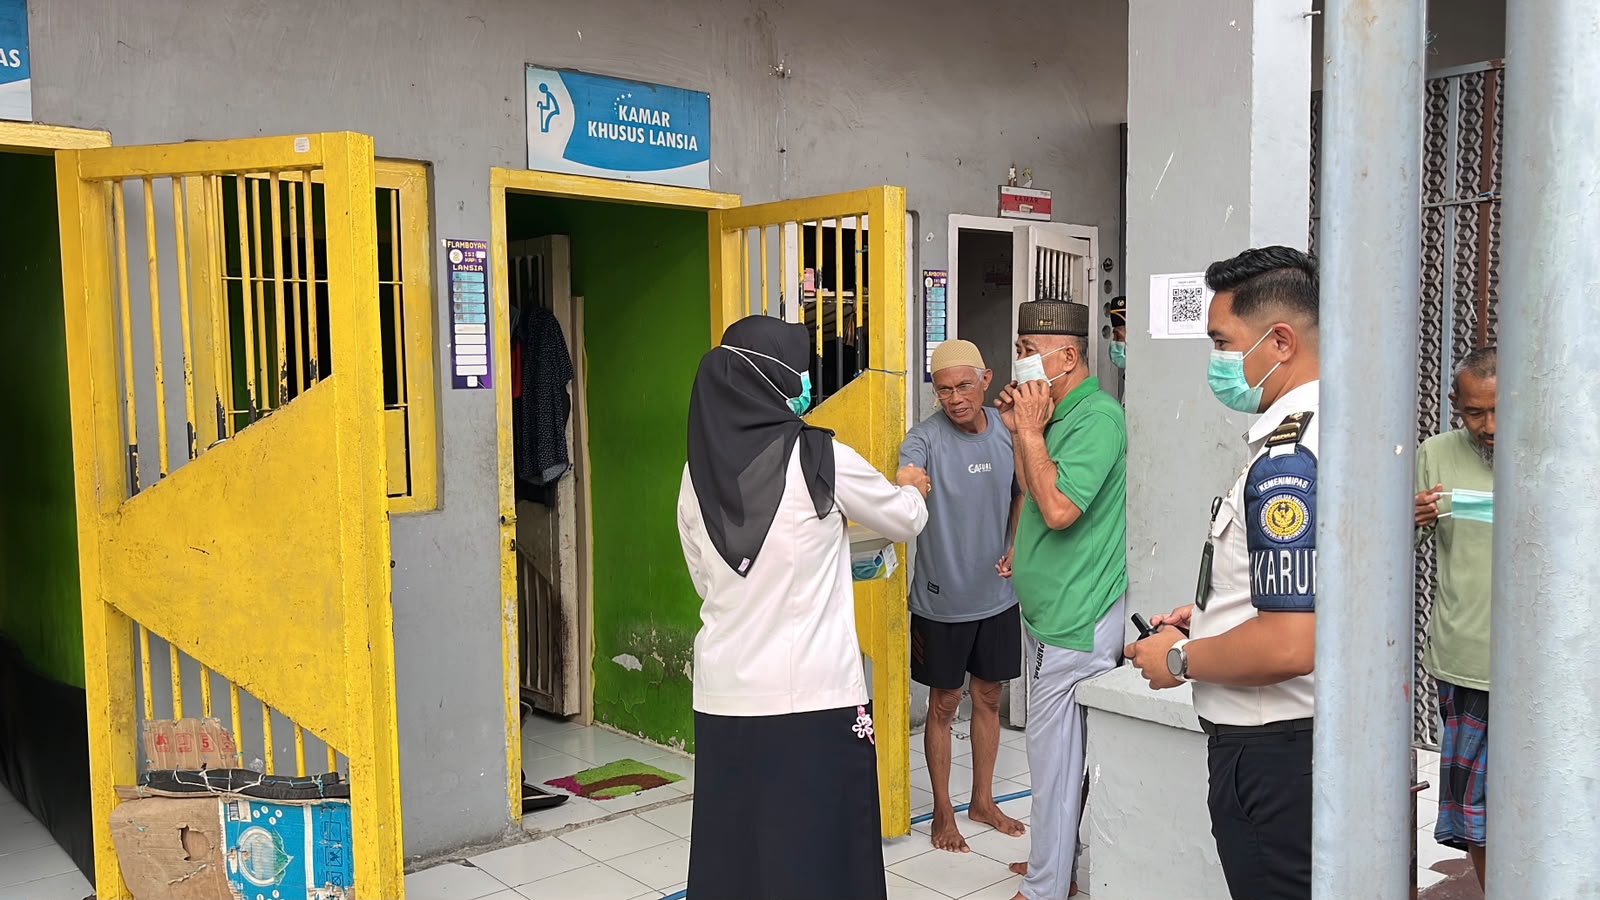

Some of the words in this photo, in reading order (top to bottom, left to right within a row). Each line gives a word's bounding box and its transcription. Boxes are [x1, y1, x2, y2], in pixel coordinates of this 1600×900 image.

[618, 104, 670, 127] KAMAR
[587, 120, 645, 144] KHUSUS
[649, 129, 698, 151] LANSIA
[447, 241, 487, 249] FLAMBOYAN
[1258, 476, 1309, 493] KEMENIMIPAS
